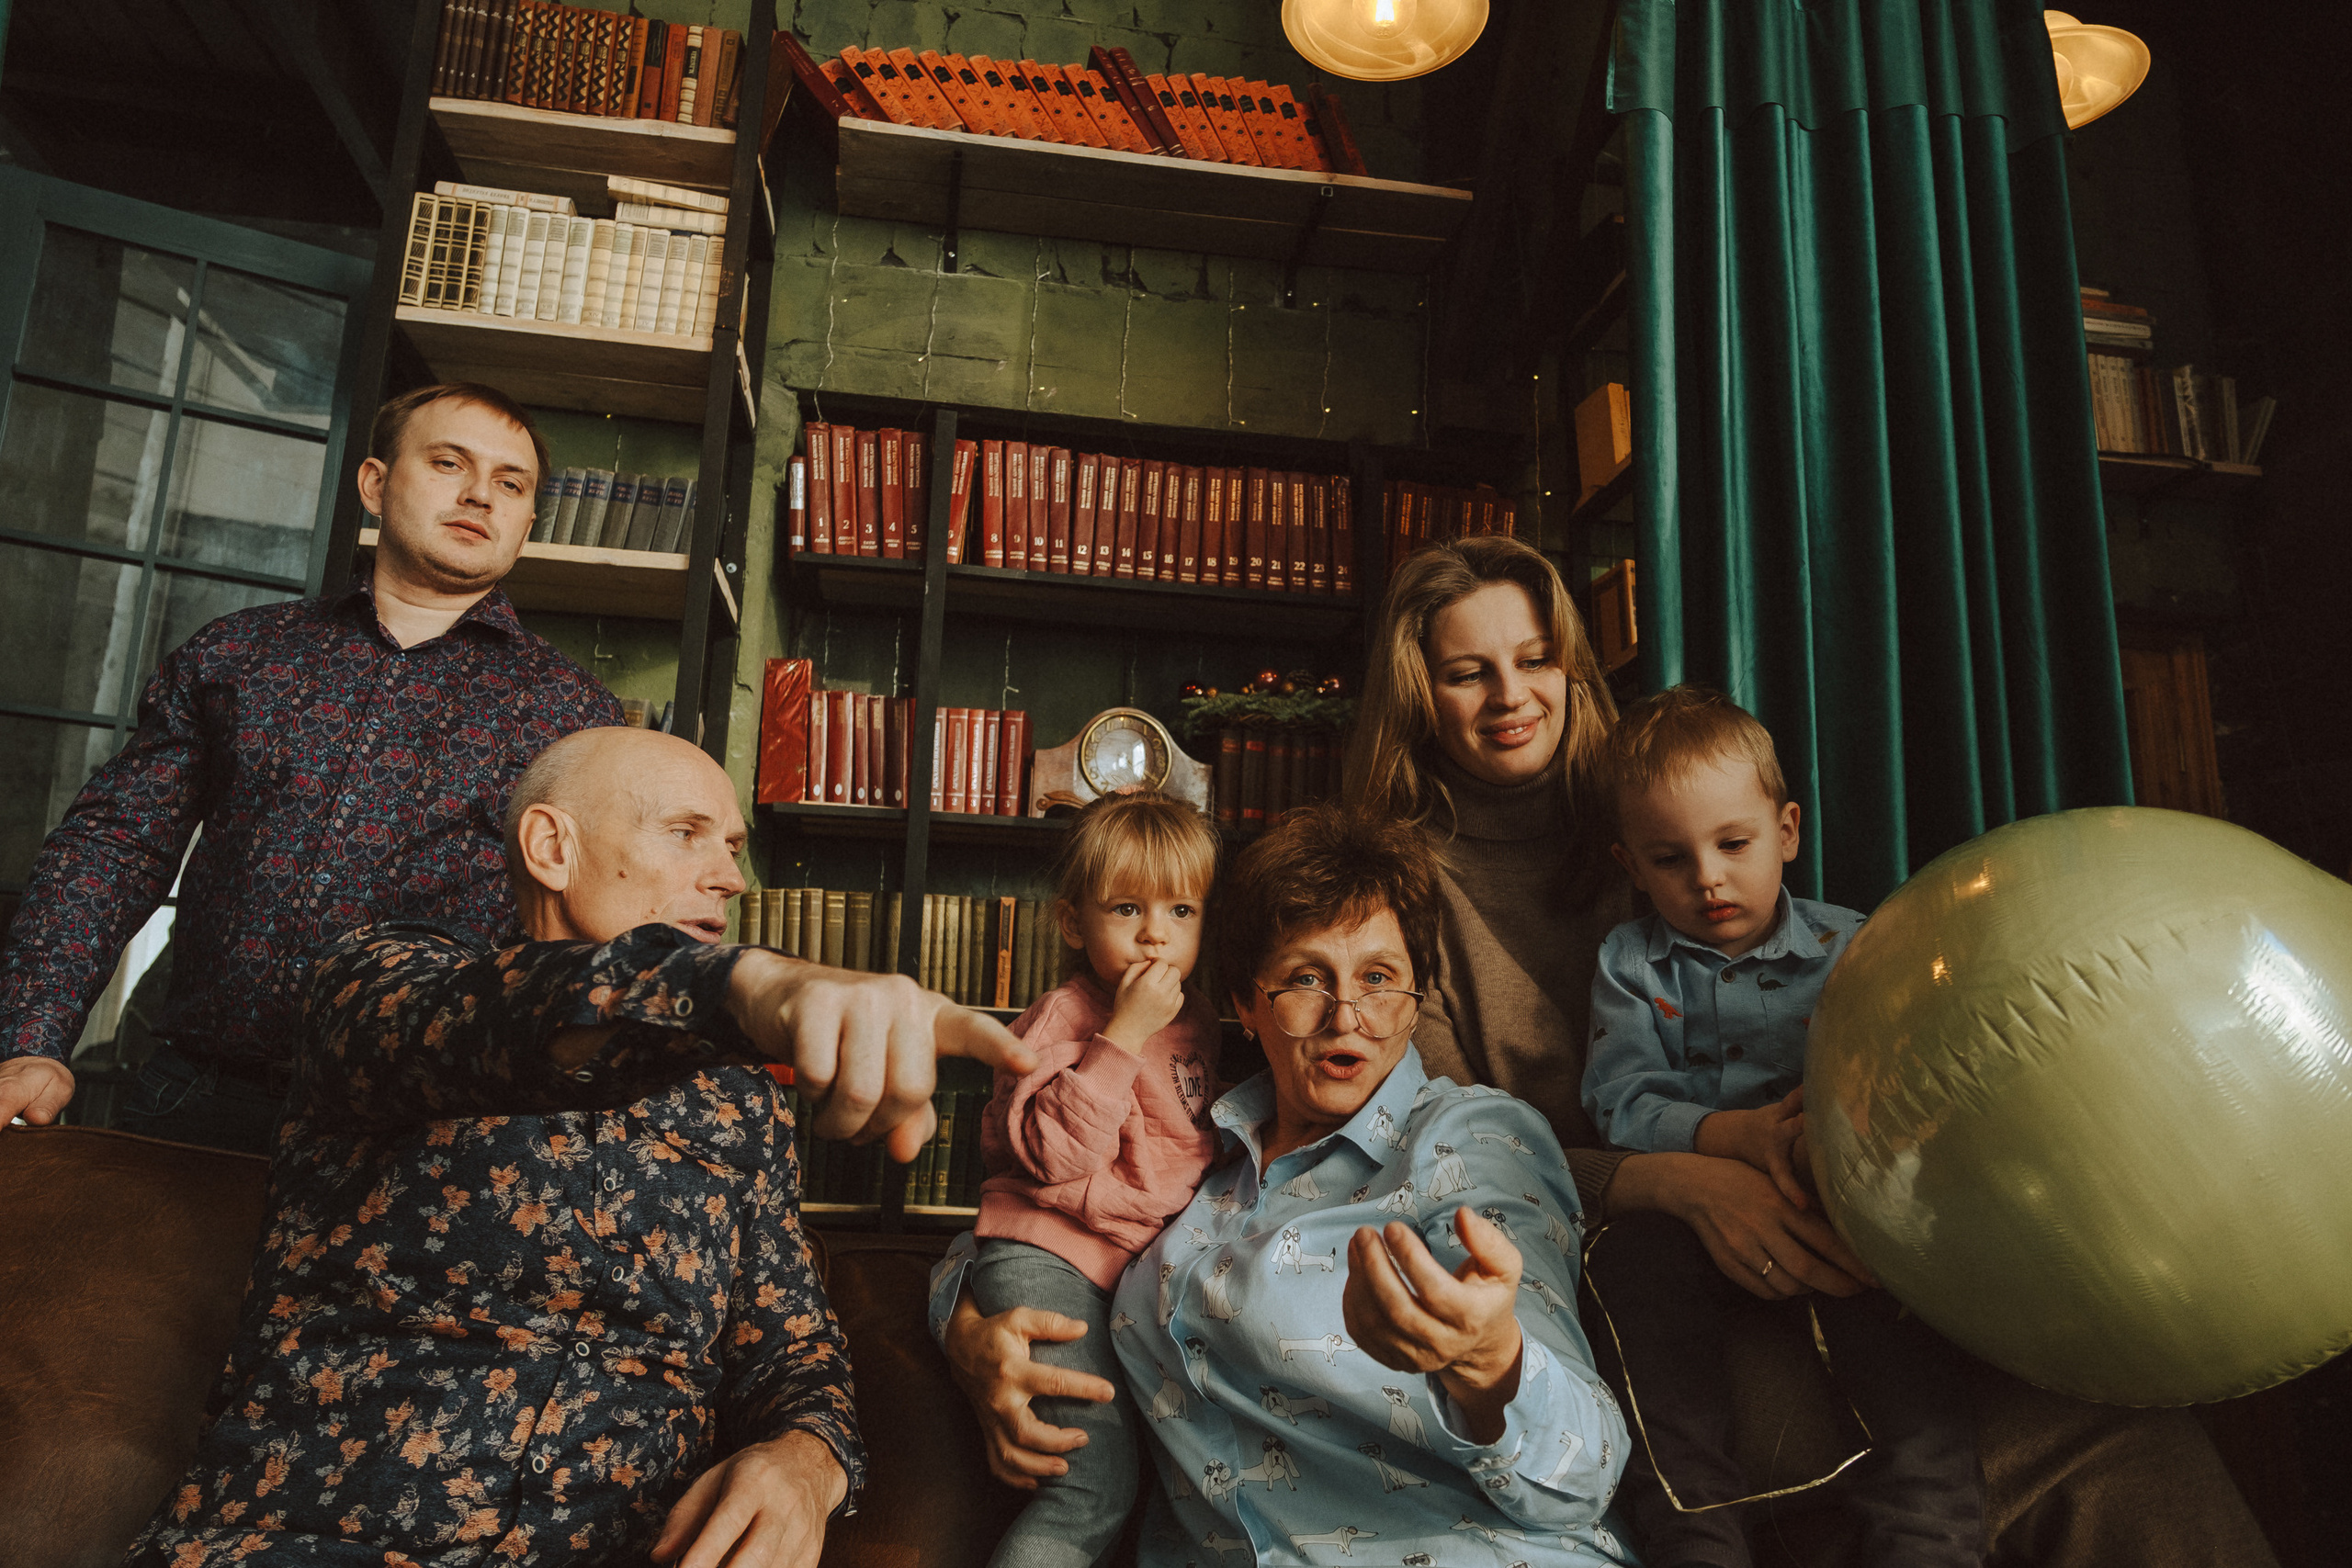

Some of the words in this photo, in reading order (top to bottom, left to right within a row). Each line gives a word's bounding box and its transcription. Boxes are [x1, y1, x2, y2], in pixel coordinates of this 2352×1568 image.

[819, 517, 823, 526] 1
[843, 520, 849, 529] 2
[865, 525, 872, 534] 3
[889, 523, 895, 532] 4
[911, 525, 917, 535] 5
[991, 534, 998, 543] 8
[1035, 537, 1044, 547] 10
[1056, 539, 1063, 548] 11
[1078, 545, 1087, 555] 12
[1100, 546, 1109, 555] 13
[1122, 548, 1130, 558] 14
[1143, 551, 1152, 560] 15
[1164, 554, 1173, 563] 16
[1185, 558, 1193, 567] 17
[1207, 558, 1216, 567] 18
[1250, 558, 1261, 567] 20
[1272, 560, 1280, 570] 21
[1295, 562, 1305, 571] 22
[1314, 564, 1324, 573] 23
[1152, 738, 1162, 750] 2
[1170, 1063, 1180, 1084] HELLO
[1184, 1077, 1203, 1098] LOVE
